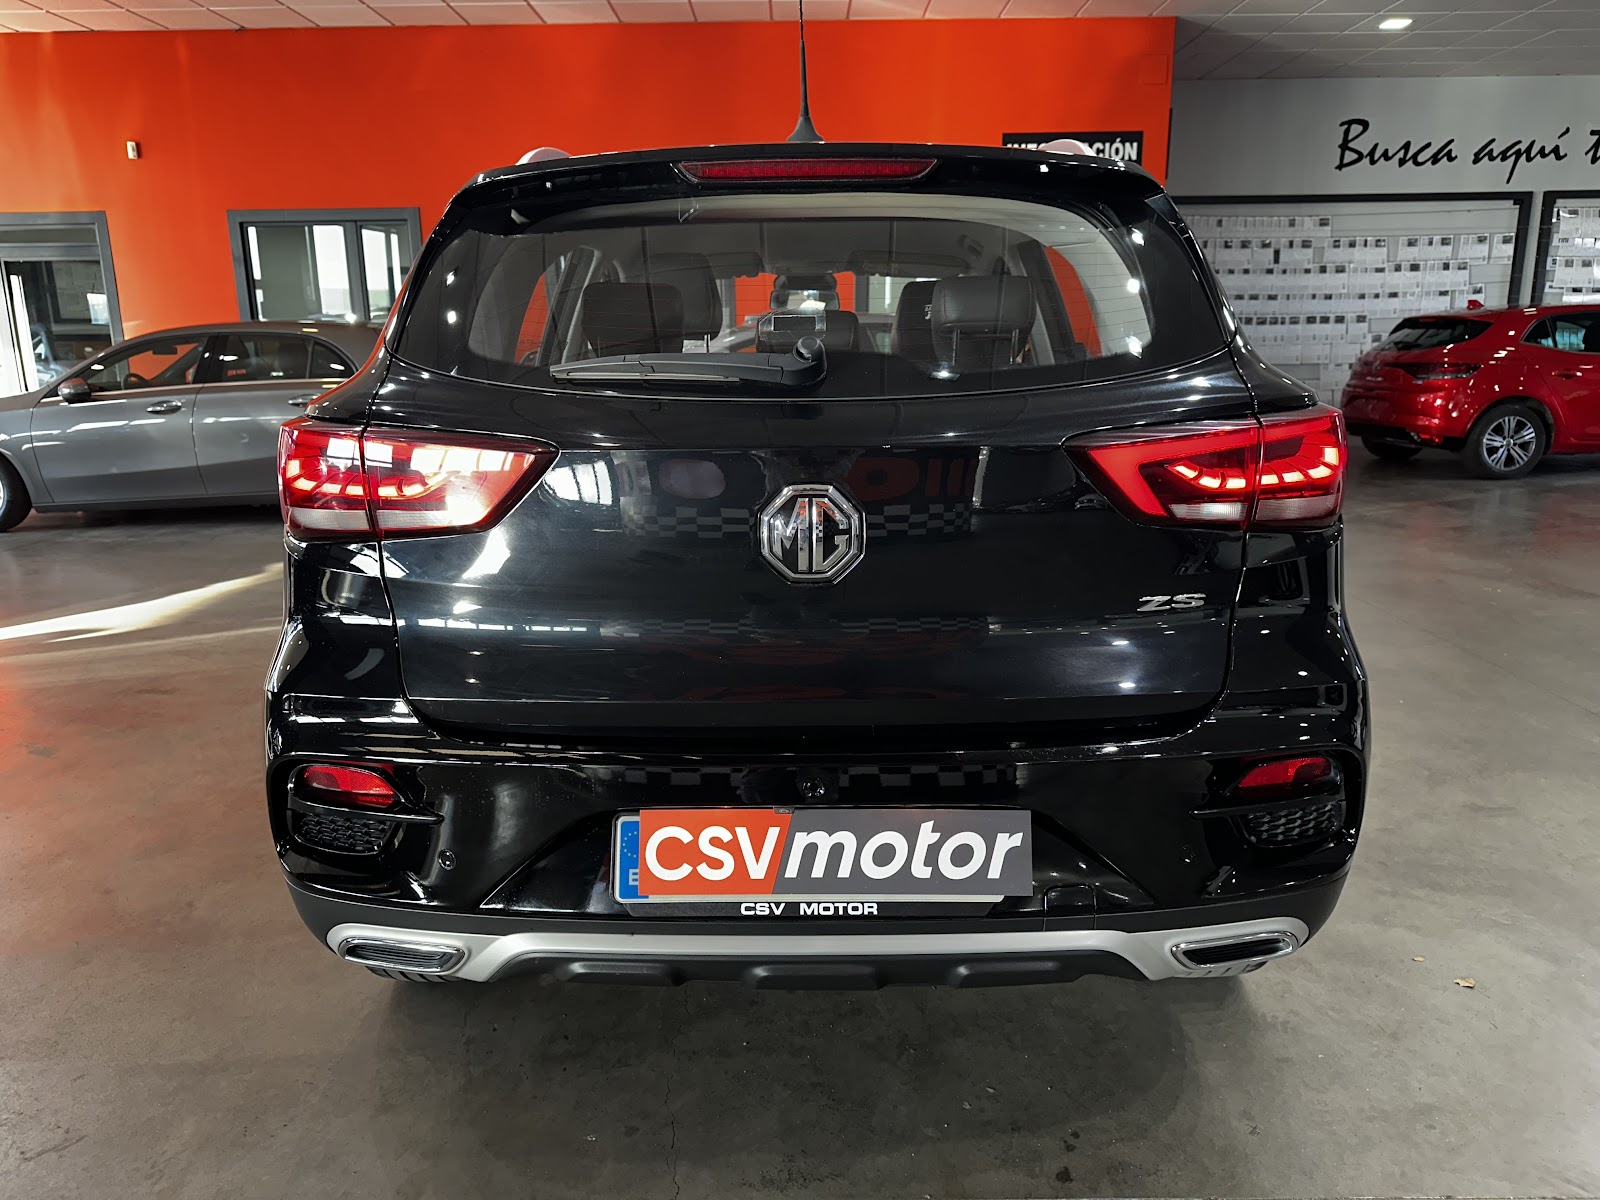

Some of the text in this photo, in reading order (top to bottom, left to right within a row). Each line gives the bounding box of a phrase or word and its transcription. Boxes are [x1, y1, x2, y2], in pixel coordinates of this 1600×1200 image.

[1334, 118, 1458, 172] Busca
[1472, 126, 1571, 185] aquí
[770, 496, 850, 573] MG
[1137, 593, 1207, 612] ZS
[740, 902, 879, 916] CSV MOTOR
